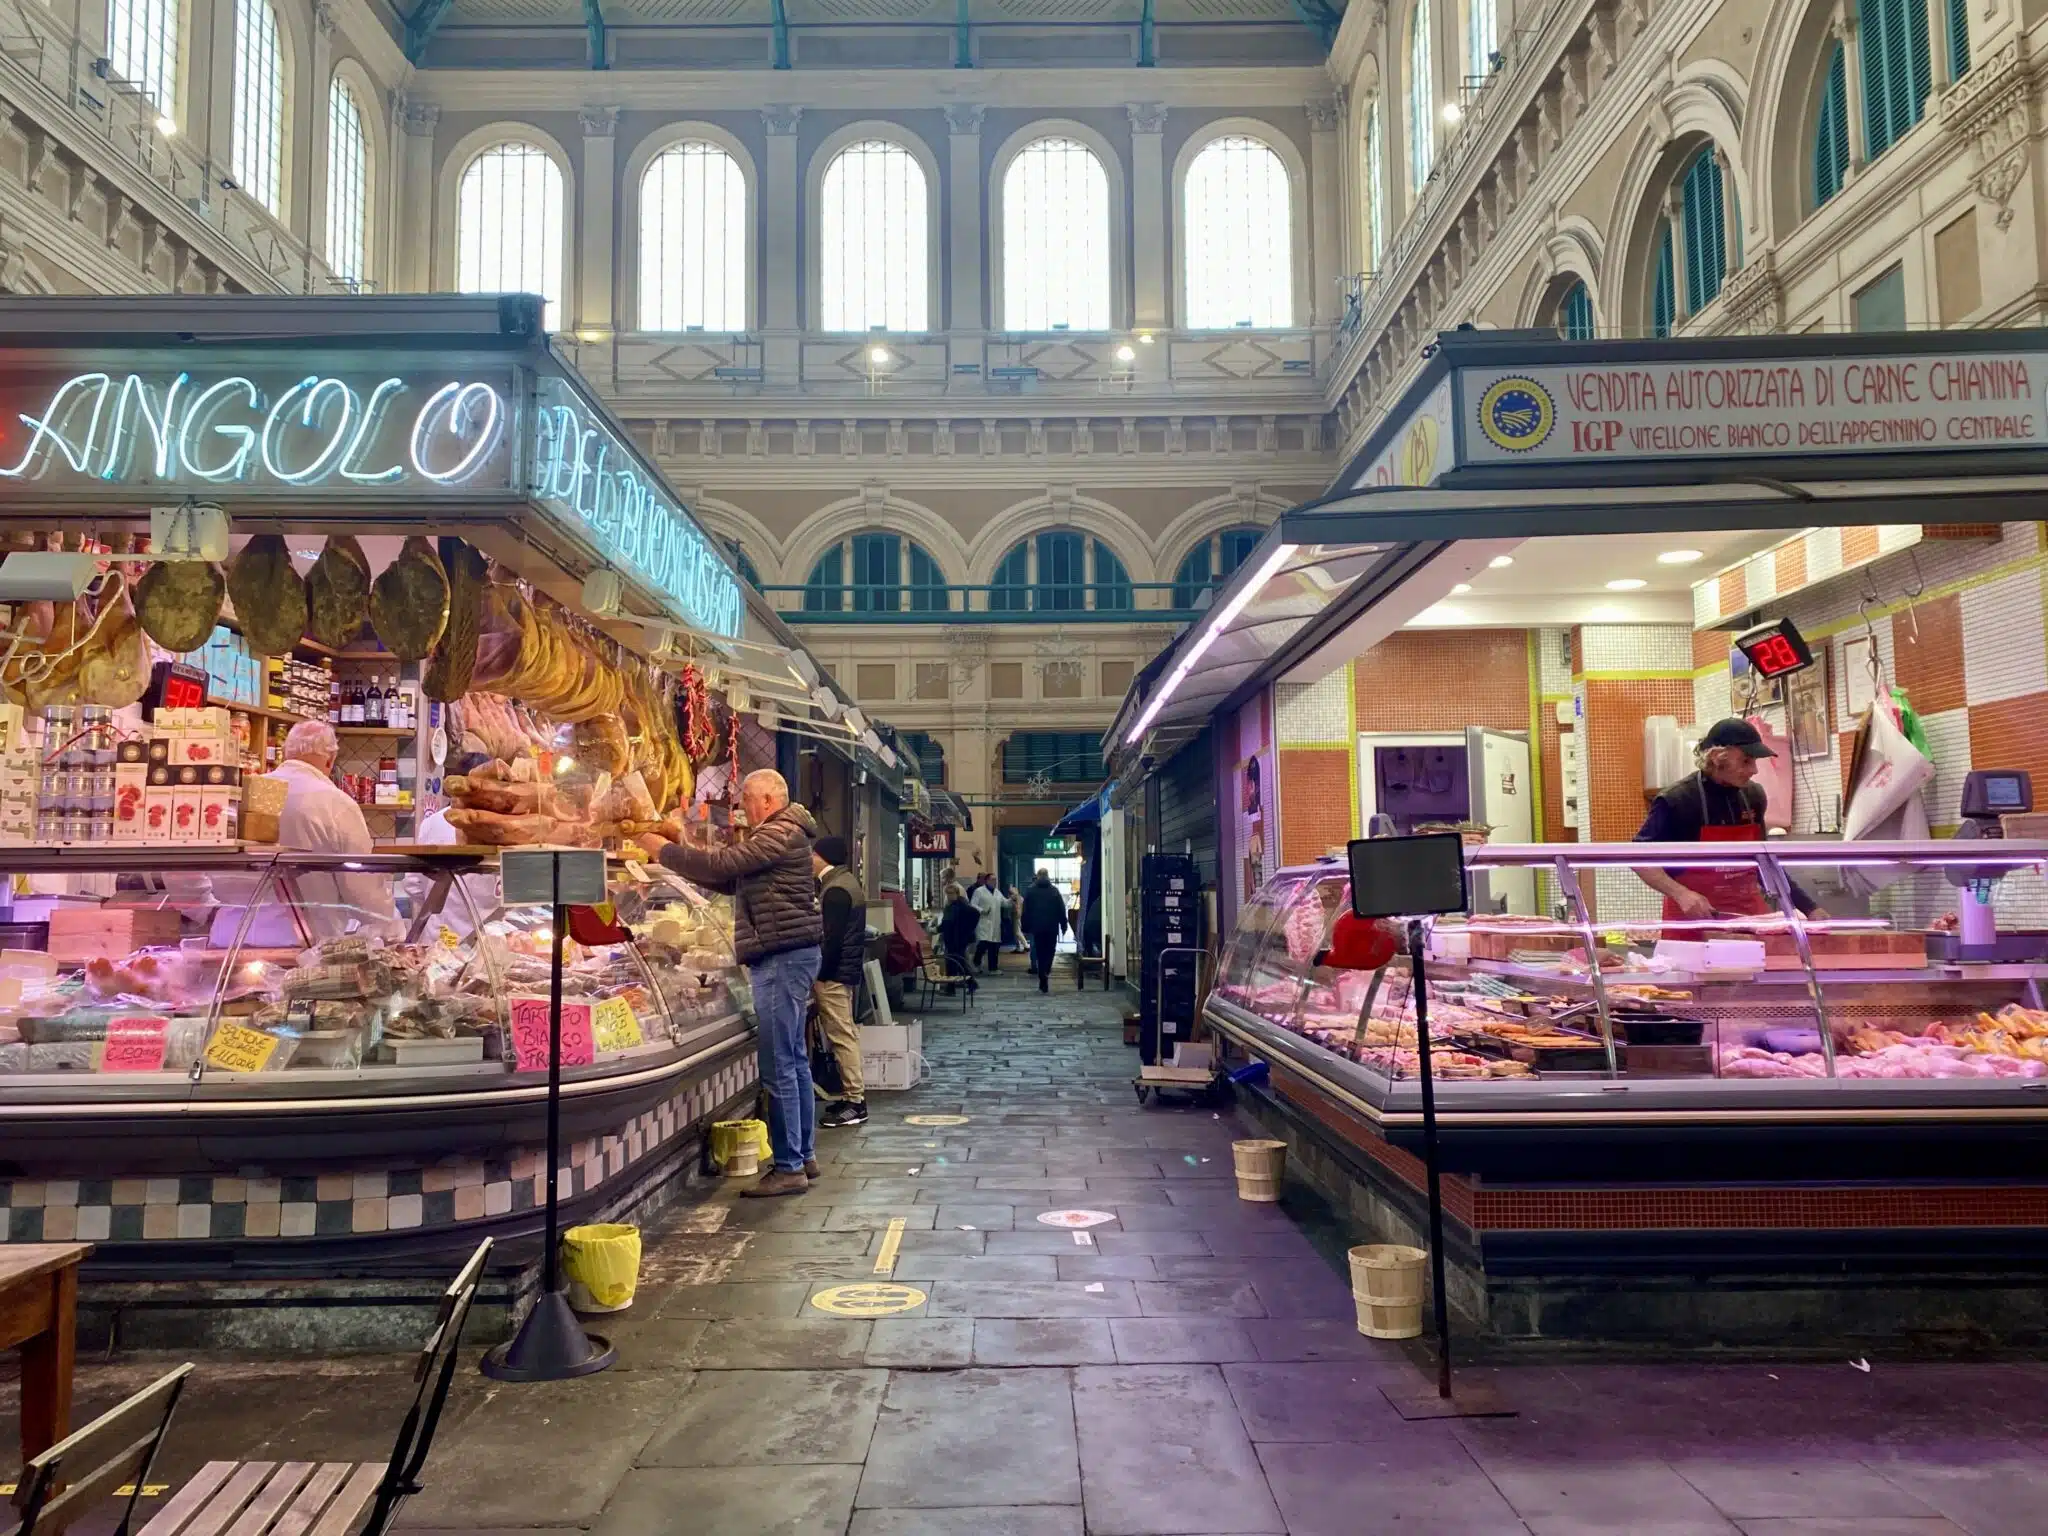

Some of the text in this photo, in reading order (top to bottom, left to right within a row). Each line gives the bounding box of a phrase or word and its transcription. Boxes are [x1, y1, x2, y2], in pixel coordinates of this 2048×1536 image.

[1566, 359, 2032, 412] VENDITA AUTORIZZATA DI CARNE CHIANINA
[0, 372, 500, 480] ANGOLO
[1569, 413, 2036, 453] IGP VITELLONE BIANCO DELL'APPENNINO CENTRALE
[1756, 635, 1797, 673] 28
[512, 1002, 582, 1027] TARTFO
[518, 1026, 583, 1048] BIACO
